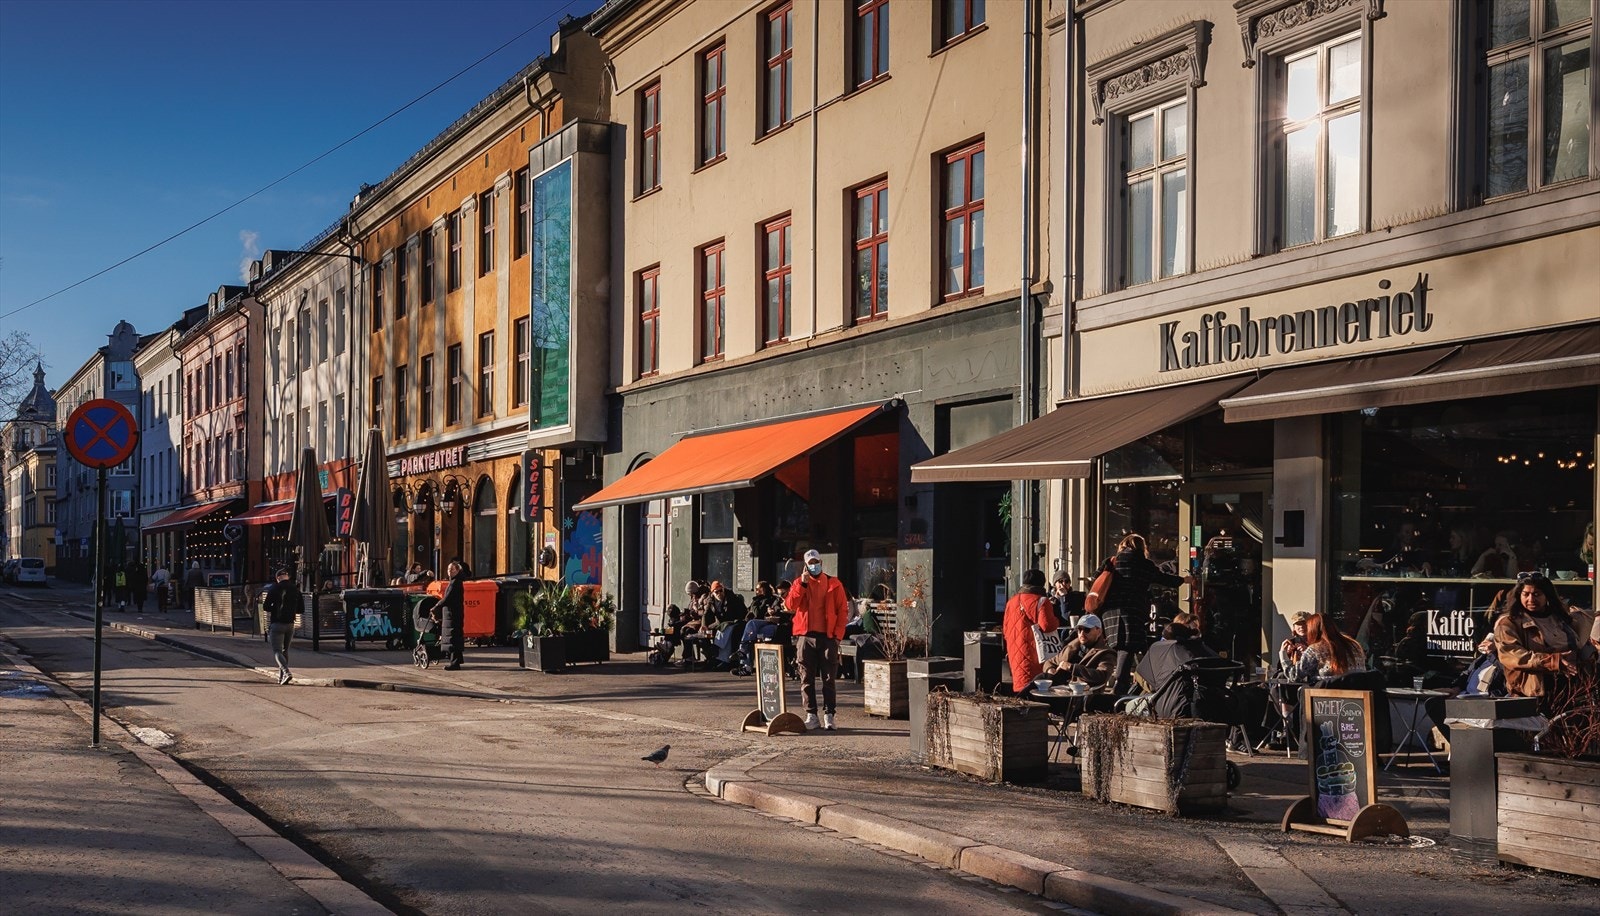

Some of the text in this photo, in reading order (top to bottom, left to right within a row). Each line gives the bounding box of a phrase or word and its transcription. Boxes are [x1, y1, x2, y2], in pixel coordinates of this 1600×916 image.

[1158, 272, 1434, 372] Kaffebrenneriet
[401, 447, 464, 476] PARKTEATRET
[529, 458, 541, 517] SCENE
[340, 493, 351, 535] BAR
[1426, 609, 1475, 637] Kaffe
[1426, 636, 1475, 652] brenneriet
